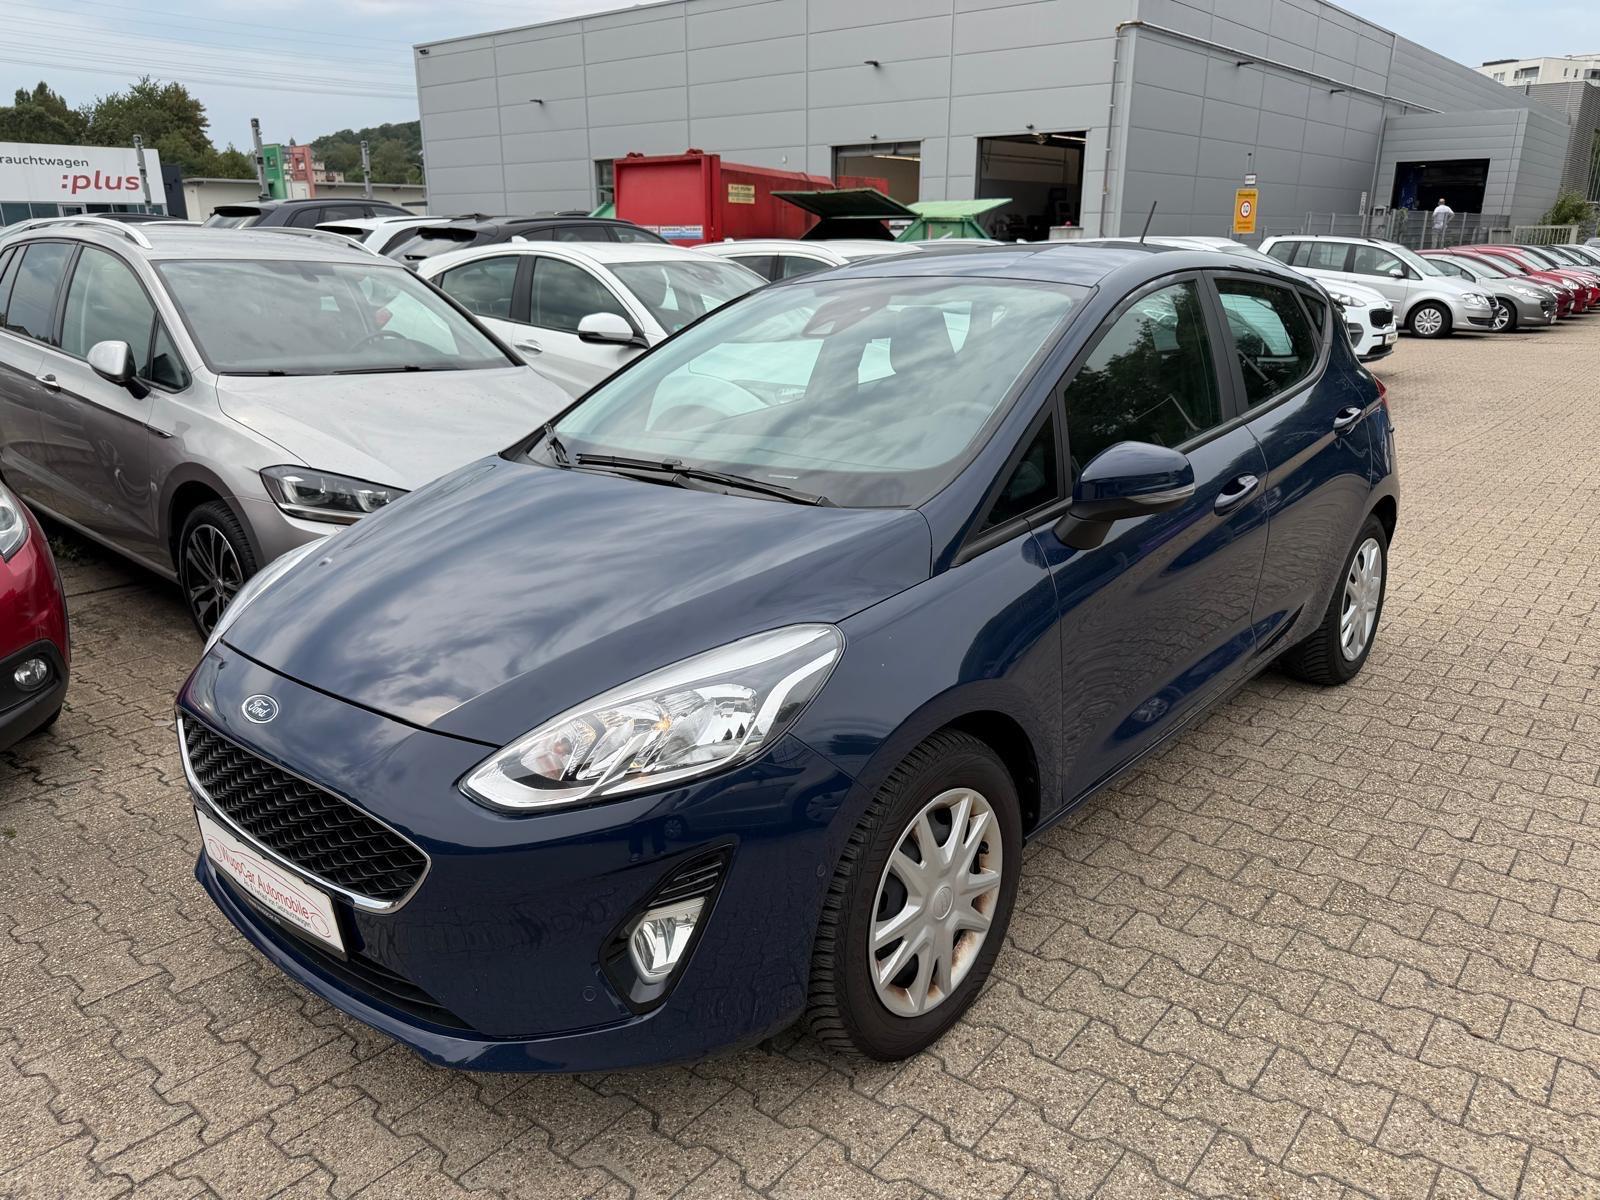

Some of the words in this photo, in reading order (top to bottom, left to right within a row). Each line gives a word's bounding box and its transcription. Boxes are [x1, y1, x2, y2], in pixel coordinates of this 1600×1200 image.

[61, 170, 140, 194] :plus
[248, 699, 270, 717] Ford
[220, 846, 255, 884] WuppCar
[258, 874, 309, 919] Automobile
